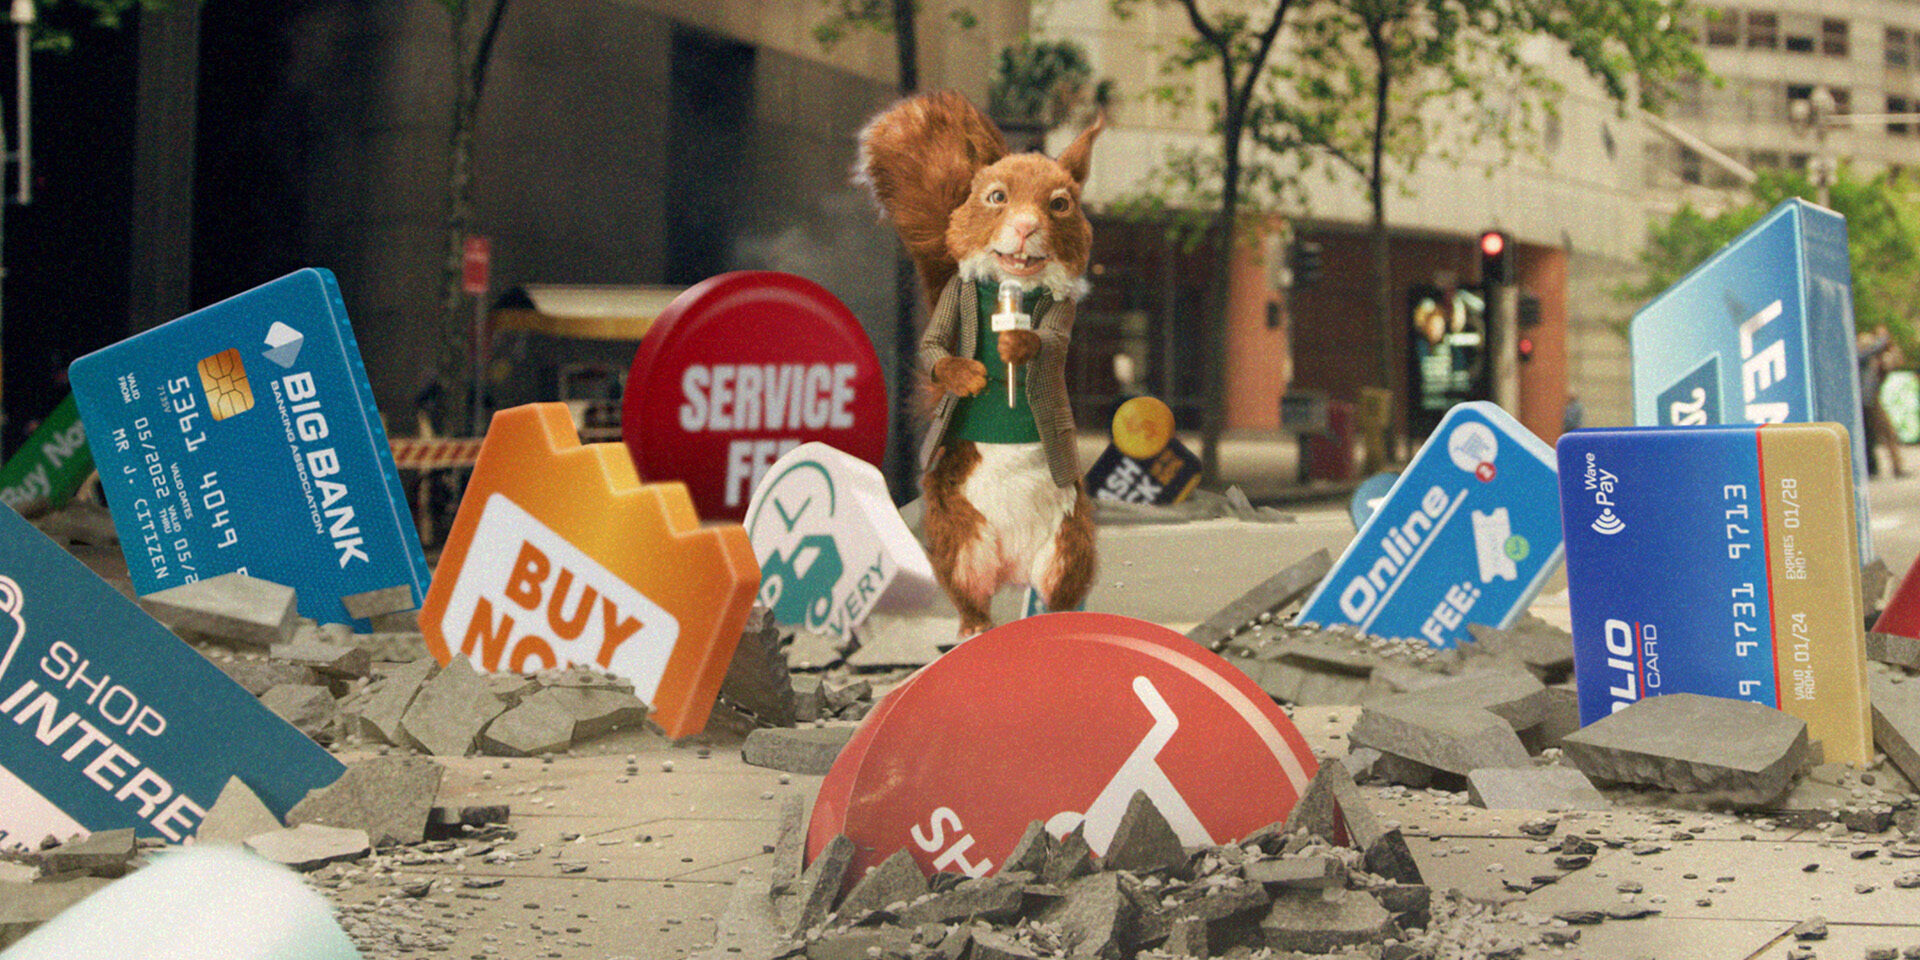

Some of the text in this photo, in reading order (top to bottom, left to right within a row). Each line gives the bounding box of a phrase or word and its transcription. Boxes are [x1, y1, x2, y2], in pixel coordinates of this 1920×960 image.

[117, 376, 132, 404] FROM
[126, 372, 141, 400] VALID
[679, 363, 857, 432] SERVICE
[134, 416, 170, 499] 05/2022
[167, 376, 238, 549] 5361 4049
[170, 462, 194, 520] VALID DATES
[270, 380, 324, 535] BANKING ASSOCIATION
[282, 371, 370, 569] BIG BANK
[725, 438, 801, 507] FE
[1584, 452, 1597, 490] Wave
[1595, 468, 1618, 506] Pay
[112, 428, 169, 579] MR J. CITIZEN
[158, 508, 172, 535] THRU
[167, 504, 181, 532] VALID
[1723, 484, 1750, 559] 9713
[1781, 478, 1800, 528] 01/28
[1339, 485, 1449, 623] Online
[1783, 535, 1796, 580] EXPIRES
[460, 595, 574, 674] NO
[504, 539, 644, 669] BUY
[1420, 581, 1482, 646] FEE:
[1731, 583, 1758, 656] 9731
[1792, 613, 1810, 662] 01/24
[40, 640, 167, 737] SHOP
[1643, 624, 1660, 688] CARD
[1792, 669, 1805, 700] VALID
[0, 679, 208, 846] INTERE
[910, 806, 994, 879] SH
